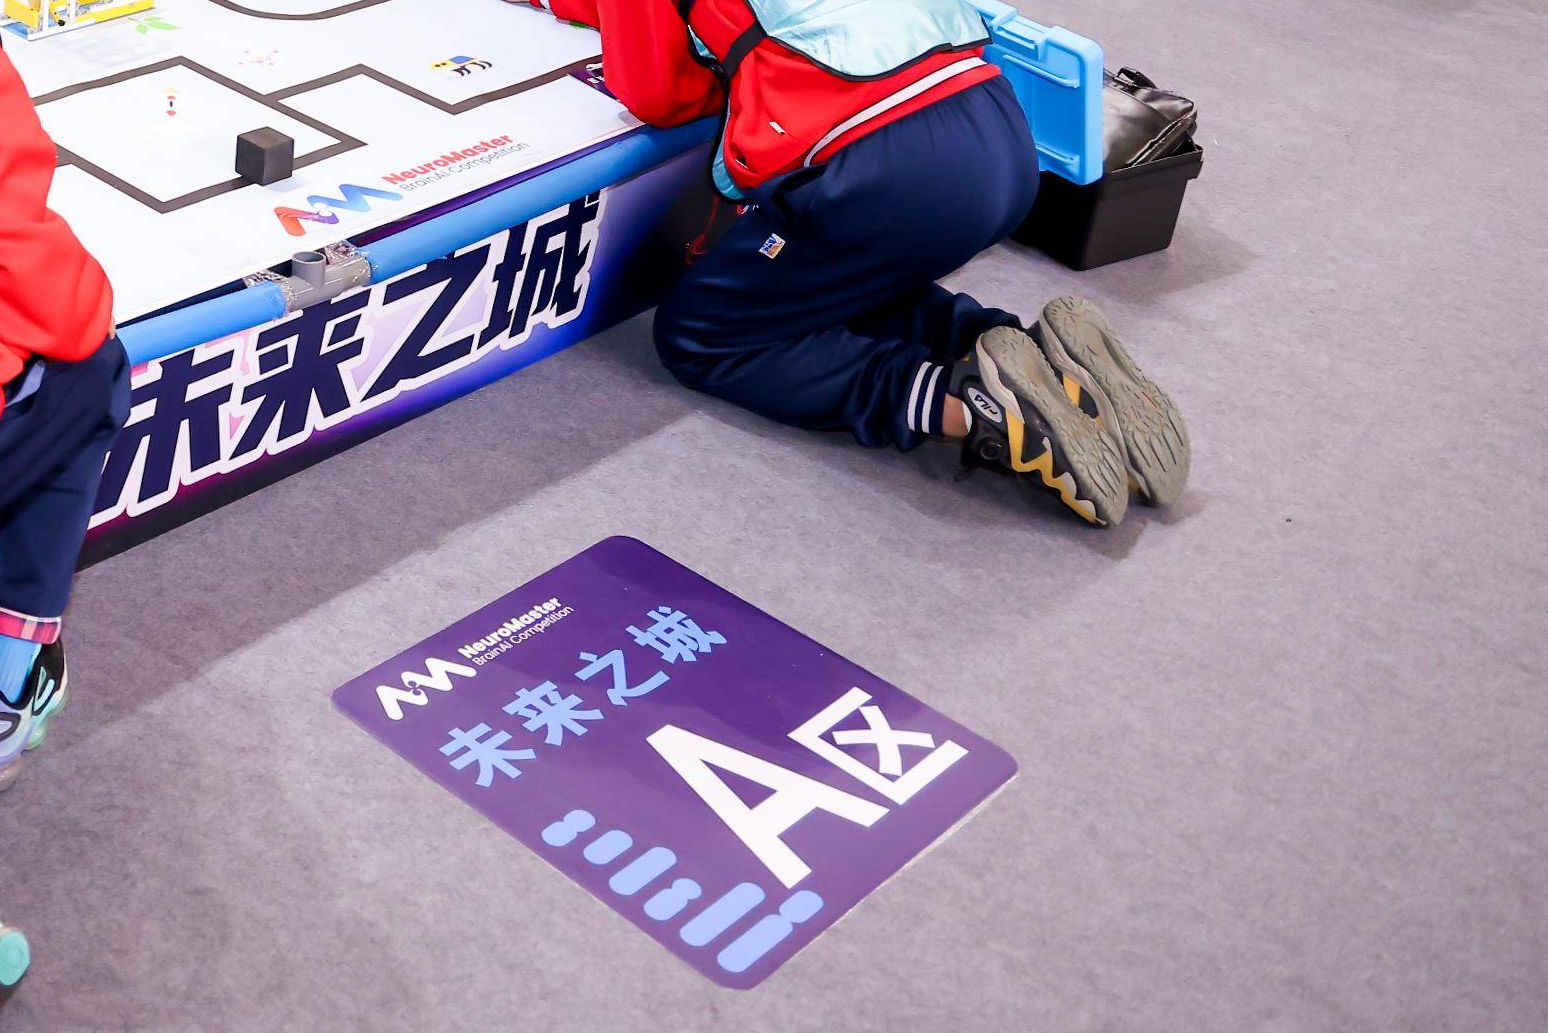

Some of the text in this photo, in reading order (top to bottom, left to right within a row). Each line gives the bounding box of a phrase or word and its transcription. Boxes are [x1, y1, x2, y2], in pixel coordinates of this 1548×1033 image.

[382, 134, 514, 185] NeuroMaster
[399, 142, 531, 192] BrainAI Competition
[88, 190, 604, 516] 未来之城
[974, 394, 998, 415] FILA
[457, 596, 562, 659] NeuroMaster
[472, 606, 575, 666] BrainAI Competition
[438, 605, 727, 788] 未来之城
[645, 685, 970, 889] A区
